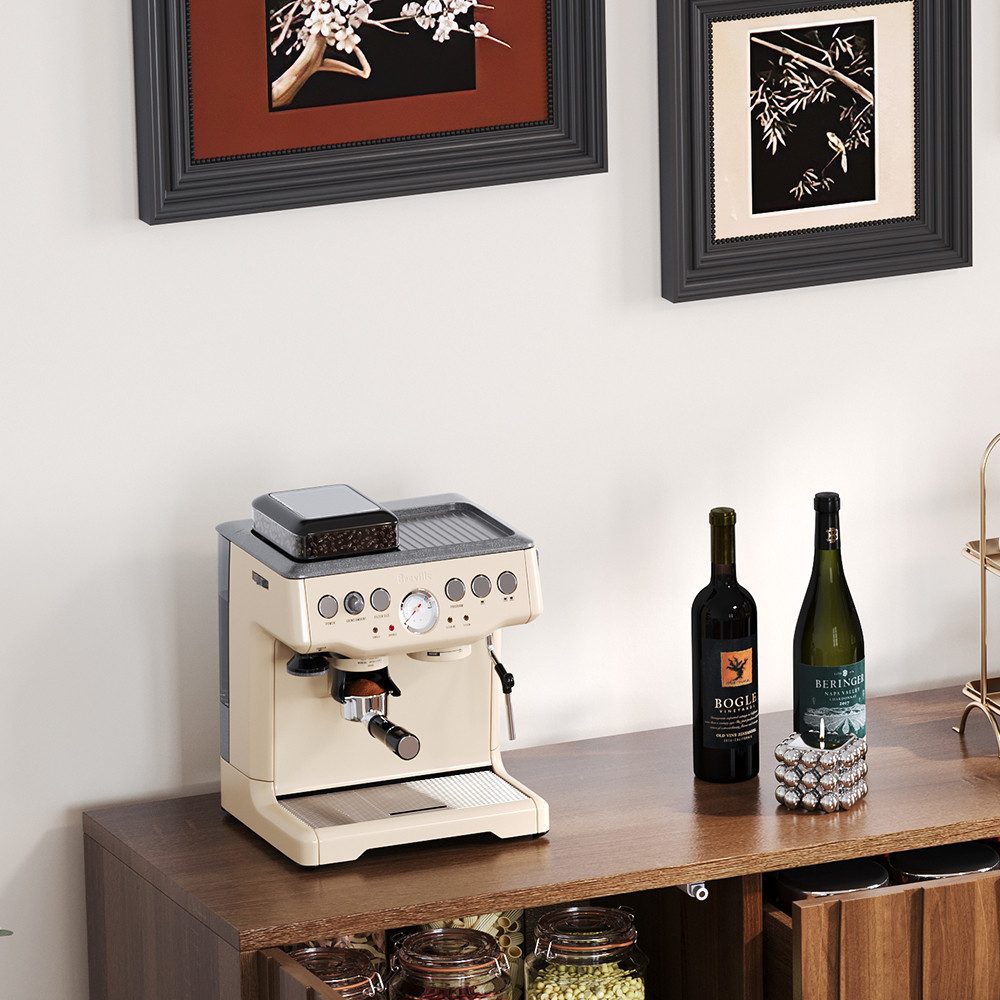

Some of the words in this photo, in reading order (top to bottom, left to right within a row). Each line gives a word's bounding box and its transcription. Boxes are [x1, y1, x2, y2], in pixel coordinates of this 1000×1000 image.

[815, 673, 865, 689] BERINGER
[714, 691, 757, 709] BOGLE
[719, 704, 756, 714] VINEYARDS
